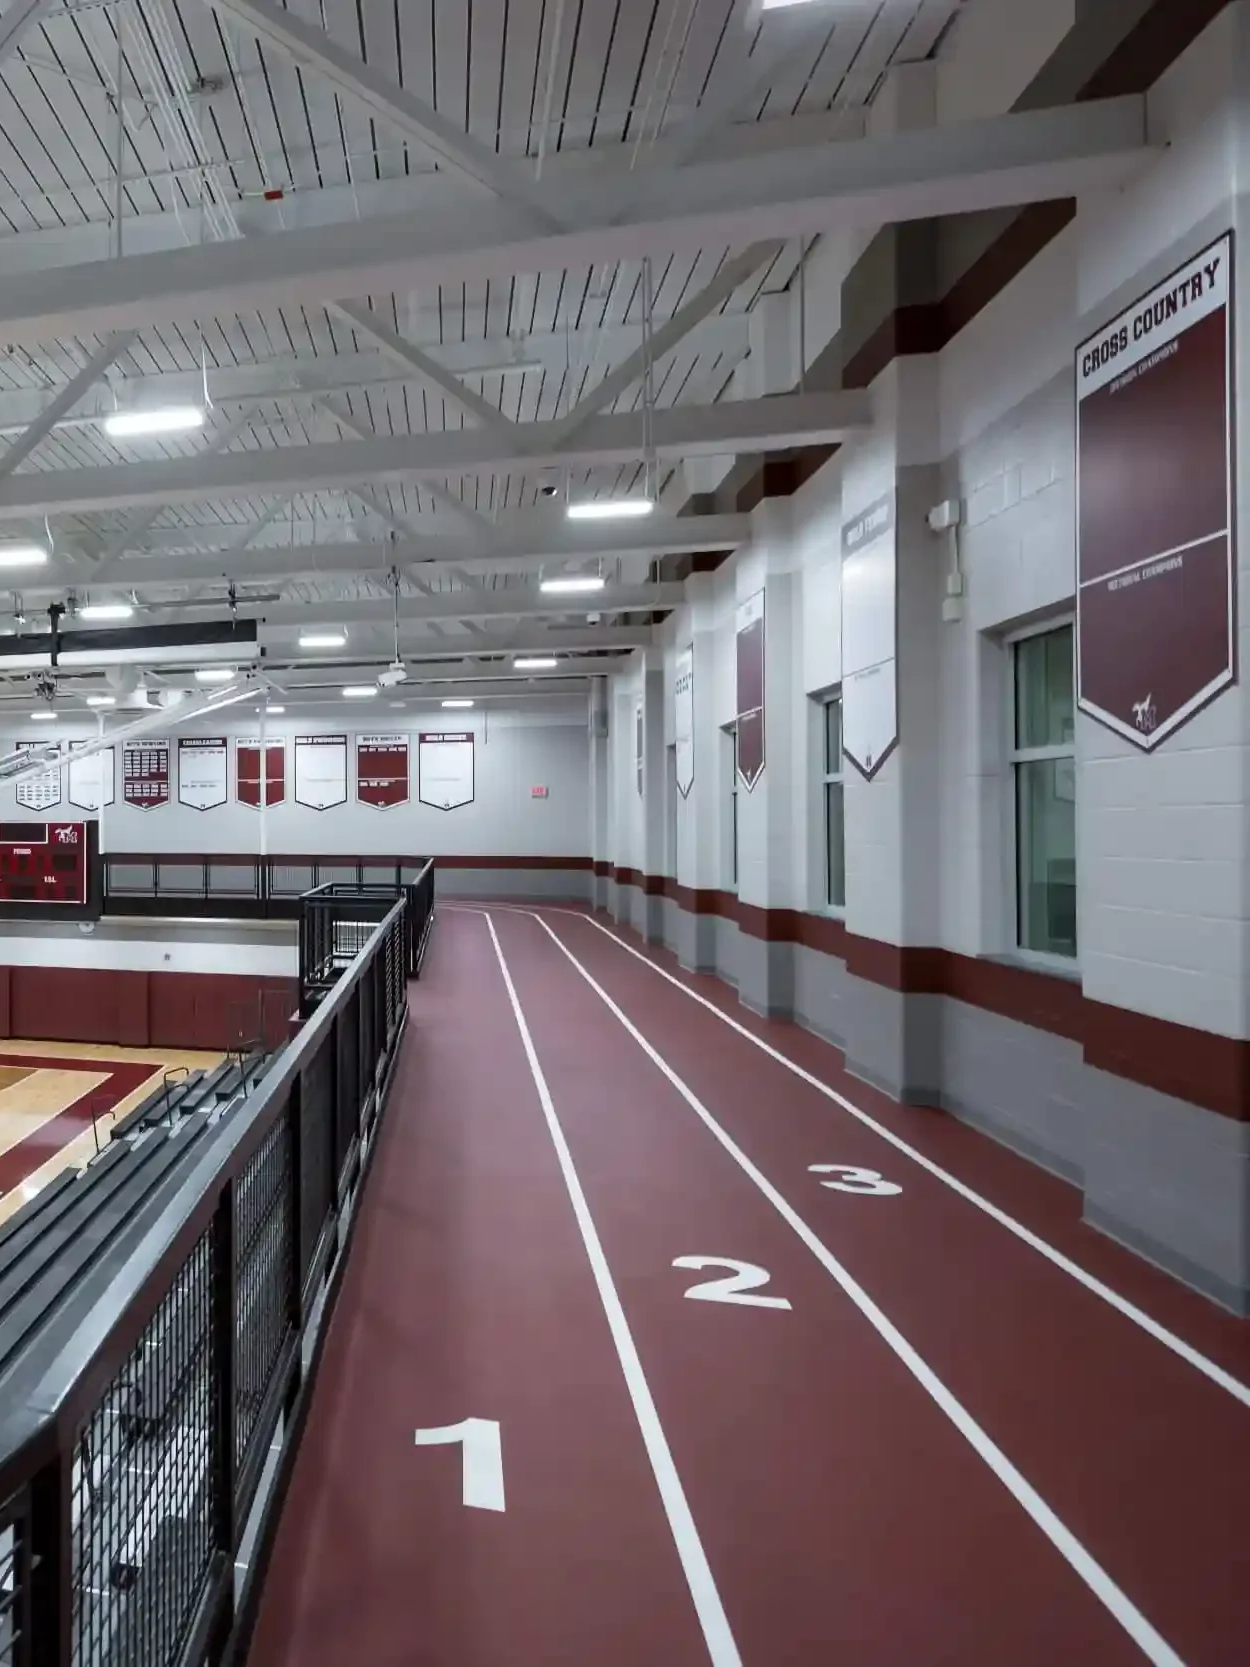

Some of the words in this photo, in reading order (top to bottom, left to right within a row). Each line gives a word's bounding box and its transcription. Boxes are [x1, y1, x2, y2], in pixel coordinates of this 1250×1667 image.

[1082, 325, 1128, 378] CROSS
[1132, 256, 1221, 342] COUNTRY
[808, 1164, 903, 1195] 3
[671, 1255, 793, 1310] 2
[415, 1417, 506, 1513] 1
